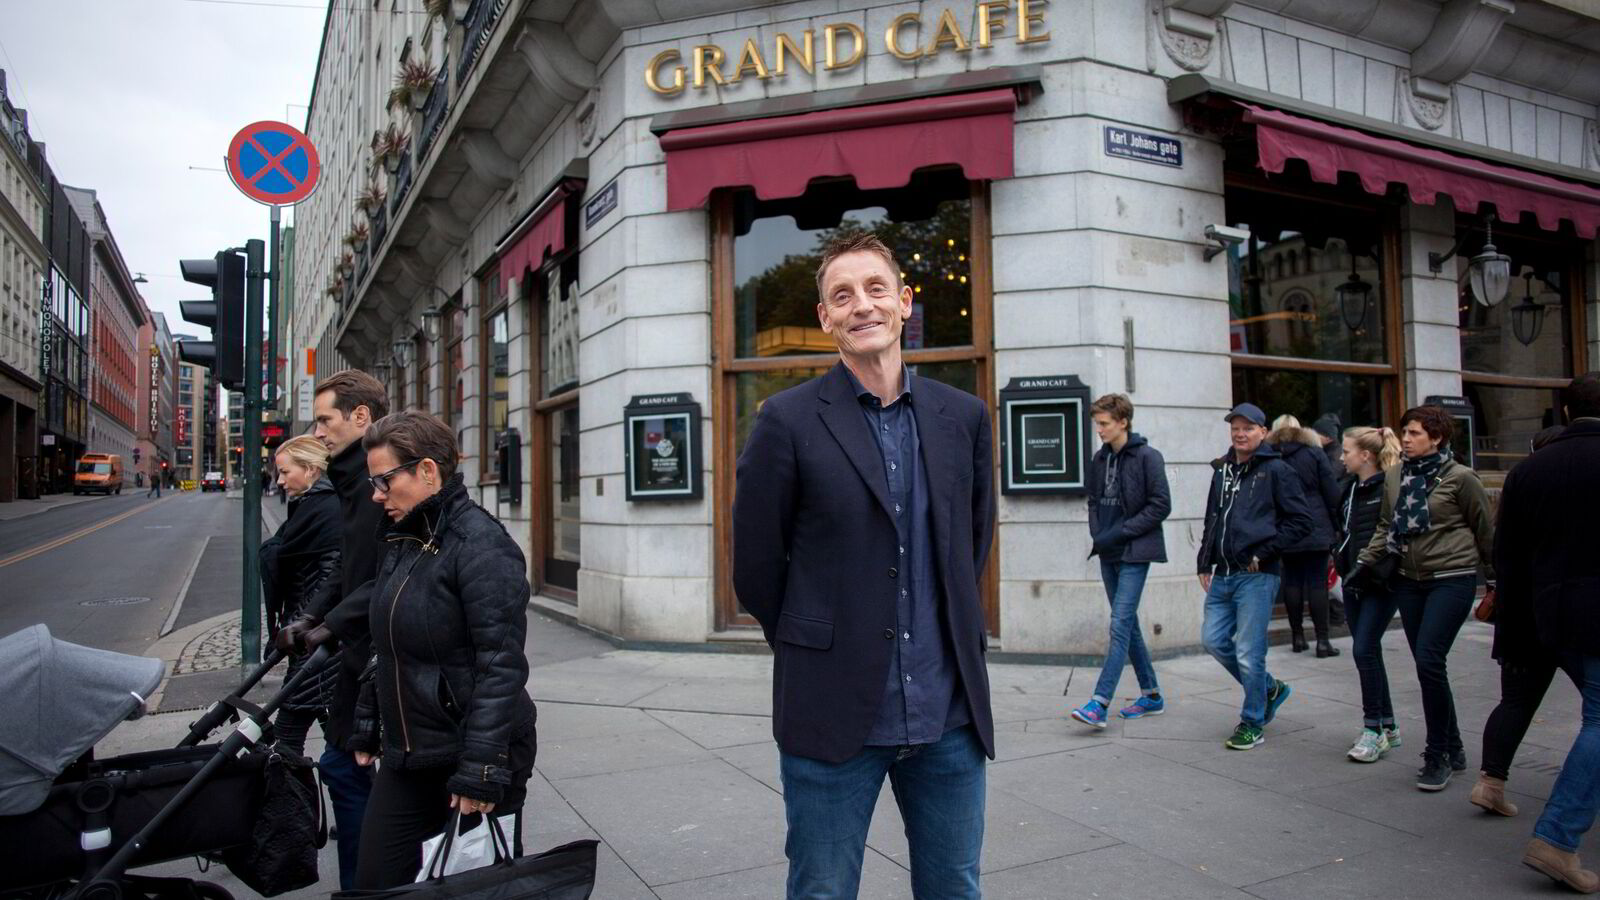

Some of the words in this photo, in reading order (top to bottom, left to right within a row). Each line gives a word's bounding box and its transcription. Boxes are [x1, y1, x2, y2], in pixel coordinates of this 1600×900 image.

[644, 22, 866, 96] GRAND
[1110, 130, 1127, 145] Karl
[1130, 134, 1158, 151] Johans
[1160, 141, 1178, 156] gate
[43, 281, 52, 375] VINMONOPOLET
[1019, 380, 1048, 388] GRAND
[639, 397, 662, 405] GRAND
